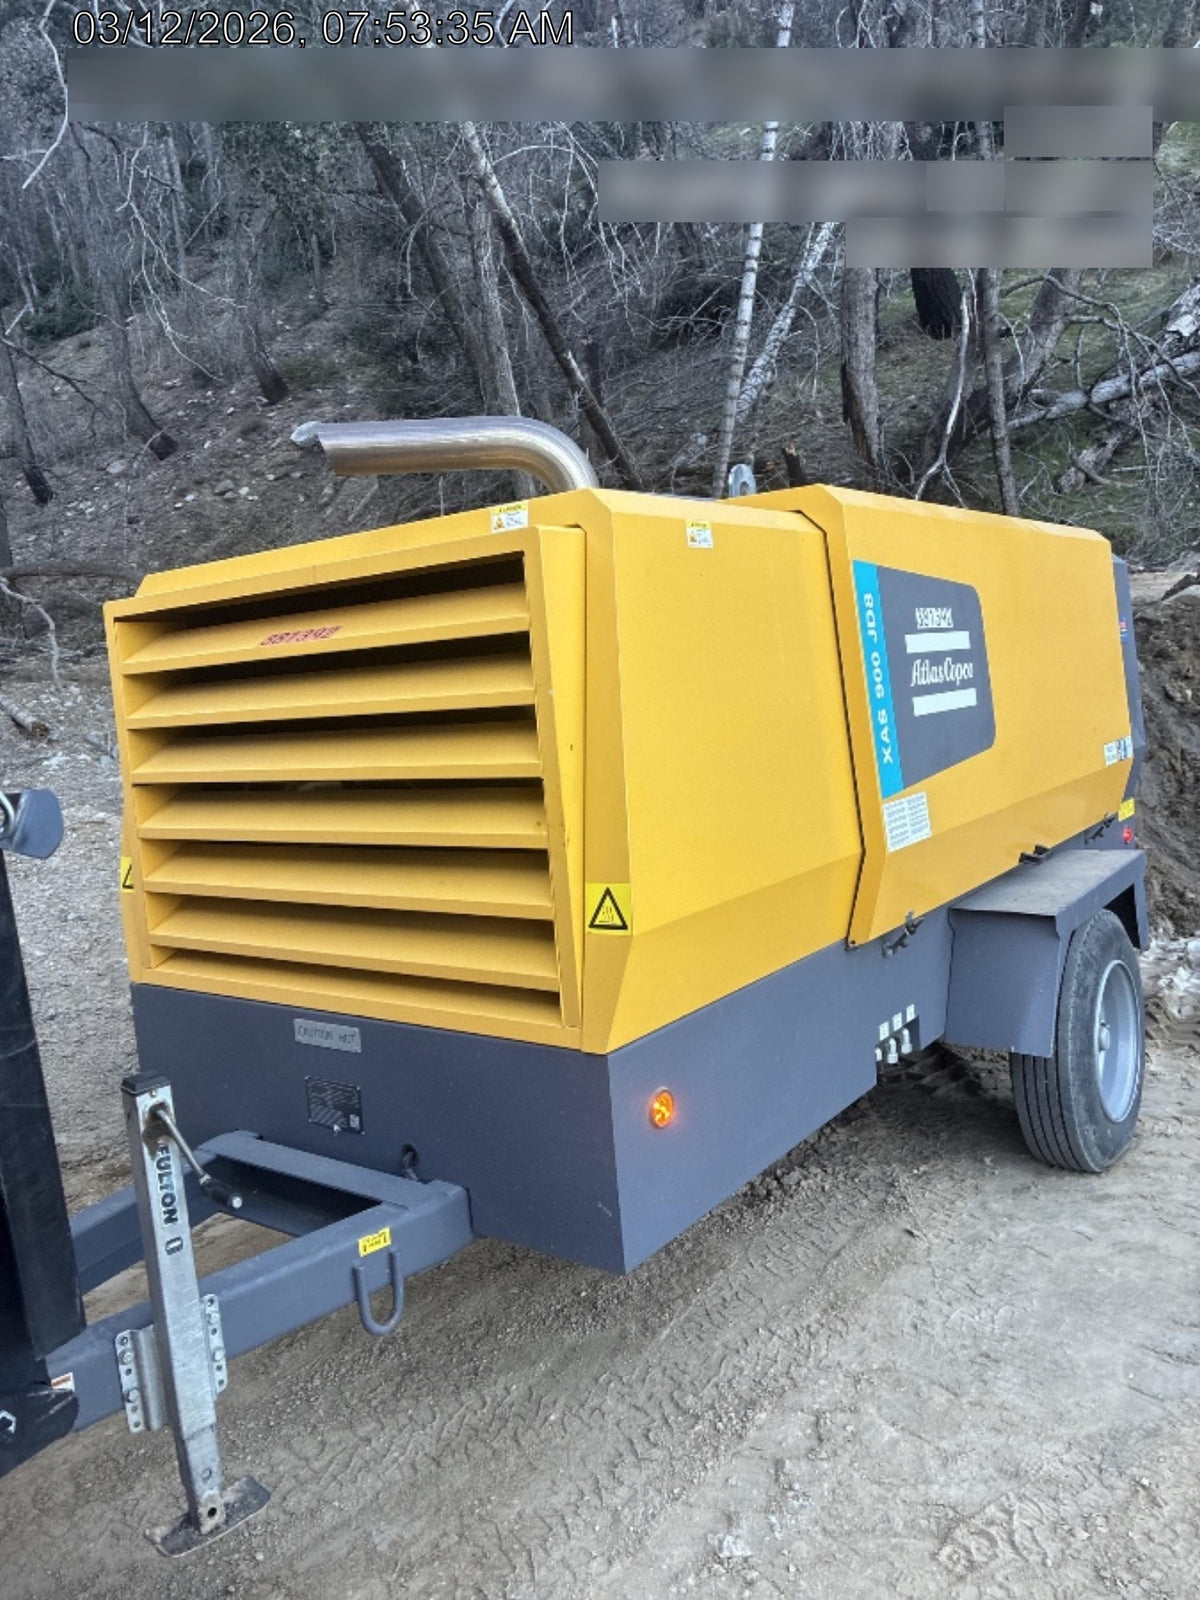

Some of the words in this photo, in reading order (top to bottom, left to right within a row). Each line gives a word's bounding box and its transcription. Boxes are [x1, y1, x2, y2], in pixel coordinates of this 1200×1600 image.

[863, 593, 878, 644] JD8
[870, 651, 885, 699] 900
[910, 658, 944, 687] Atlas
[943, 656, 974, 687] Copco
[878, 708, 894, 765] XAS
[155, 1142, 179, 1225] FULTON
